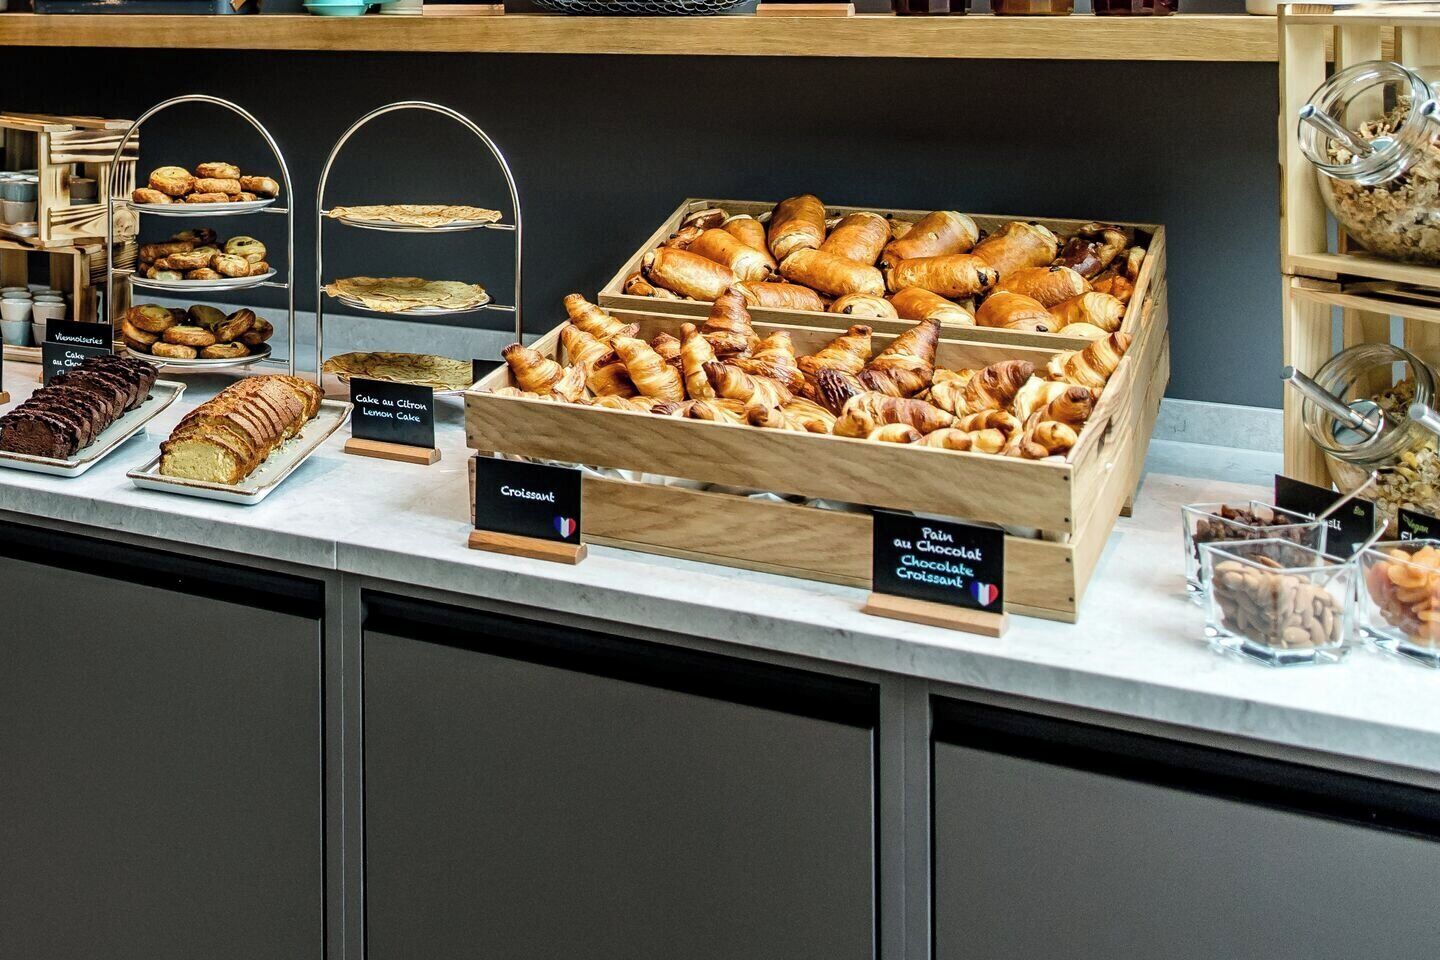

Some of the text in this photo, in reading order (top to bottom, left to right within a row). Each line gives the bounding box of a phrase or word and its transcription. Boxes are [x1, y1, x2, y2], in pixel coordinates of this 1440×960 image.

[54, 332, 103, 345] Viennoiseries
[65, 350, 85, 361] Cake
[355, 394, 428, 411] Cake au Citron
[363, 407, 421, 423] Lemon Cake
[500, 485, 556, 503] Croissant
[921, 526, 954, 543] Pain
[1408, 518, 1429, 535] Vegan
[893, 538, 982, 561] au Chocolat
[901, 554, 975, 577] Chocolate
[896, 566, 963, 588] Croissant
